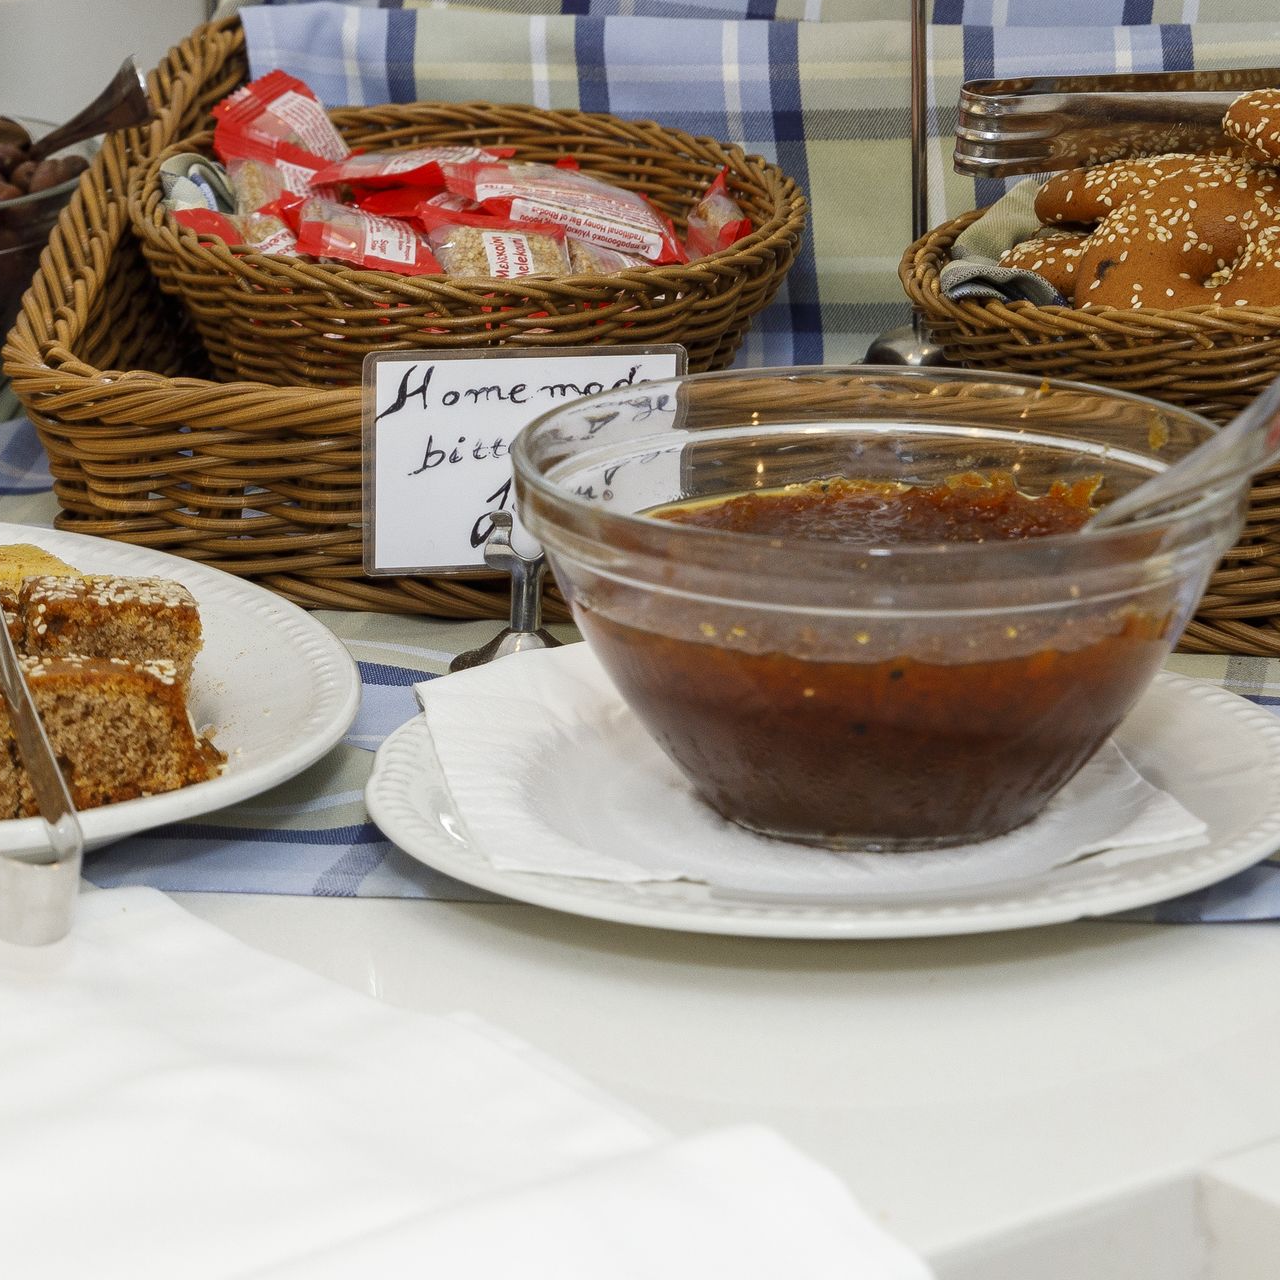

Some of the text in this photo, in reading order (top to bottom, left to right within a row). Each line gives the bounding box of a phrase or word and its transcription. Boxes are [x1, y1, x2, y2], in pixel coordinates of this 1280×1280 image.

[569, 215, 582, 227] Bar
[583, 218, 607, 231] Honey
[607, 224, 646, 243] Traditional
